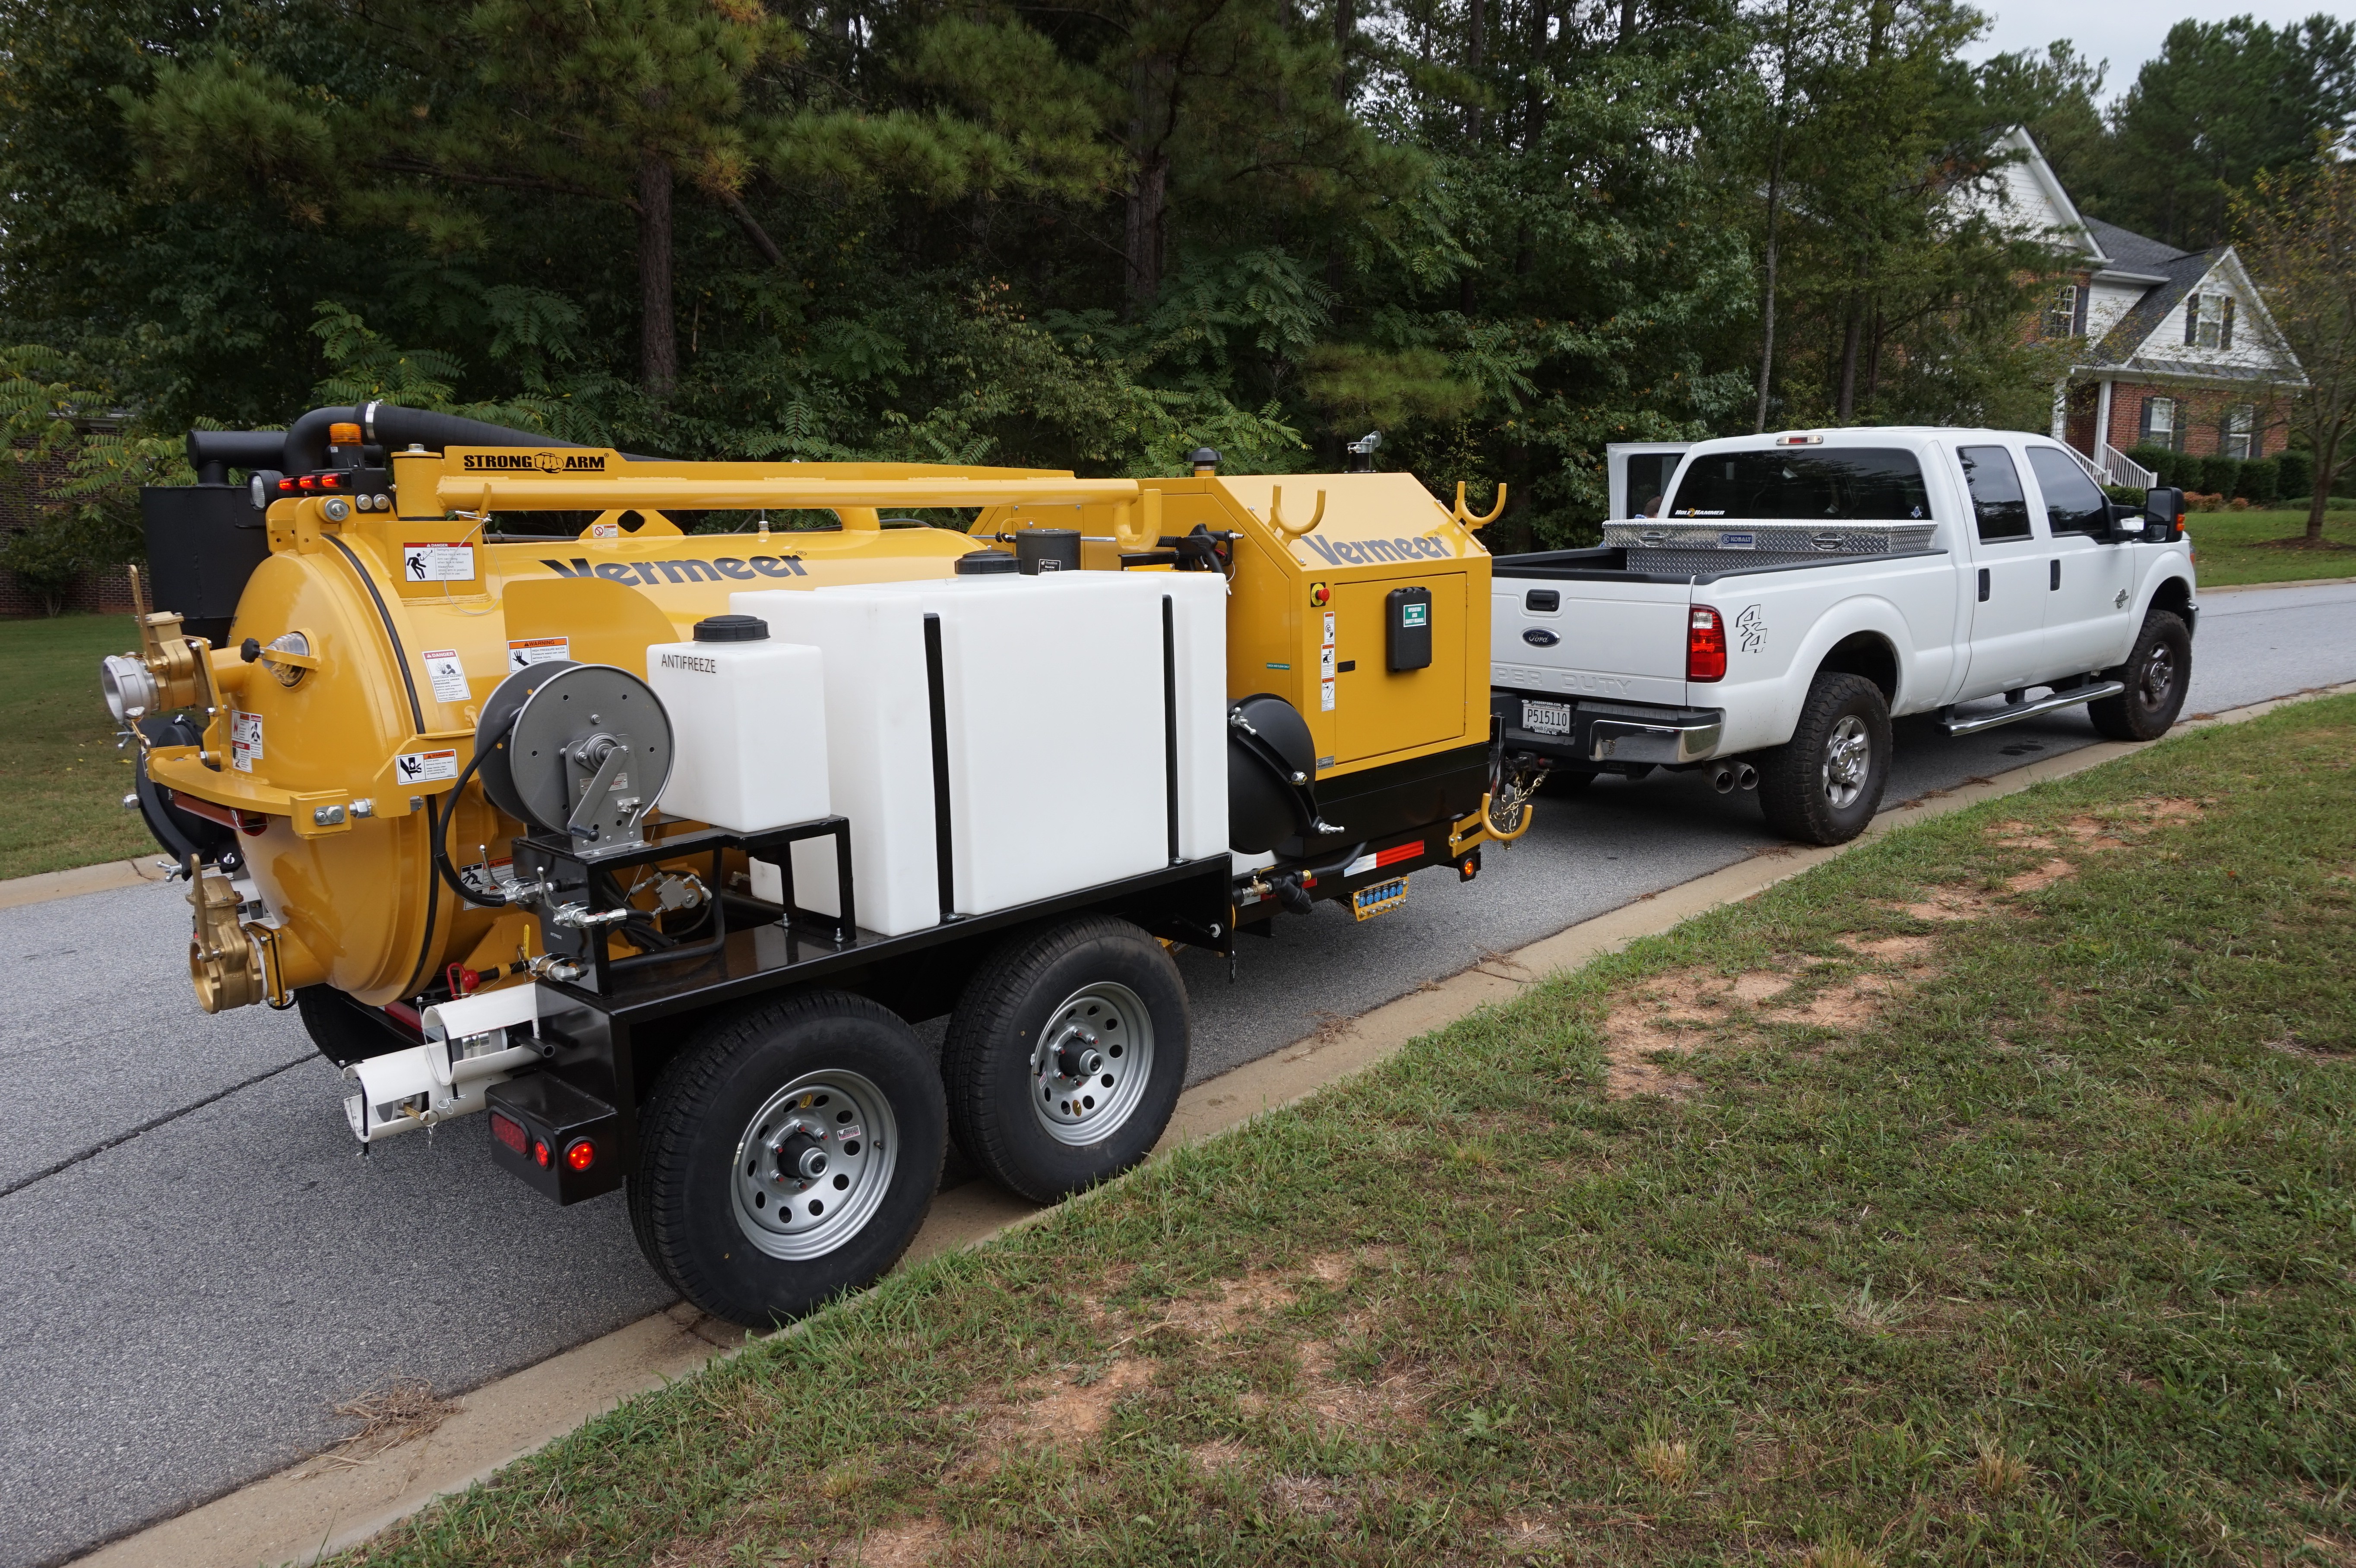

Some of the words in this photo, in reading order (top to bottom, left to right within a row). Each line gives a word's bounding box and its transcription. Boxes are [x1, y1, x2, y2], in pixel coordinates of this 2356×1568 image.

[464, 455, 532, 468] STRONG
[565, 456, 605, 468] ARM
[1301, 534, 1452, 566] Vermeer
[538, 555, 808, 586] Vermeer
[1529, 631, 1549, 642] Ford
[662, 654, 716, 673] ANTIFREEZE
[1495, 667, 1542, 686] PER
[1561, 674, 1631, 695] DUTY
[1528, 709, 1567, 726] P515110
